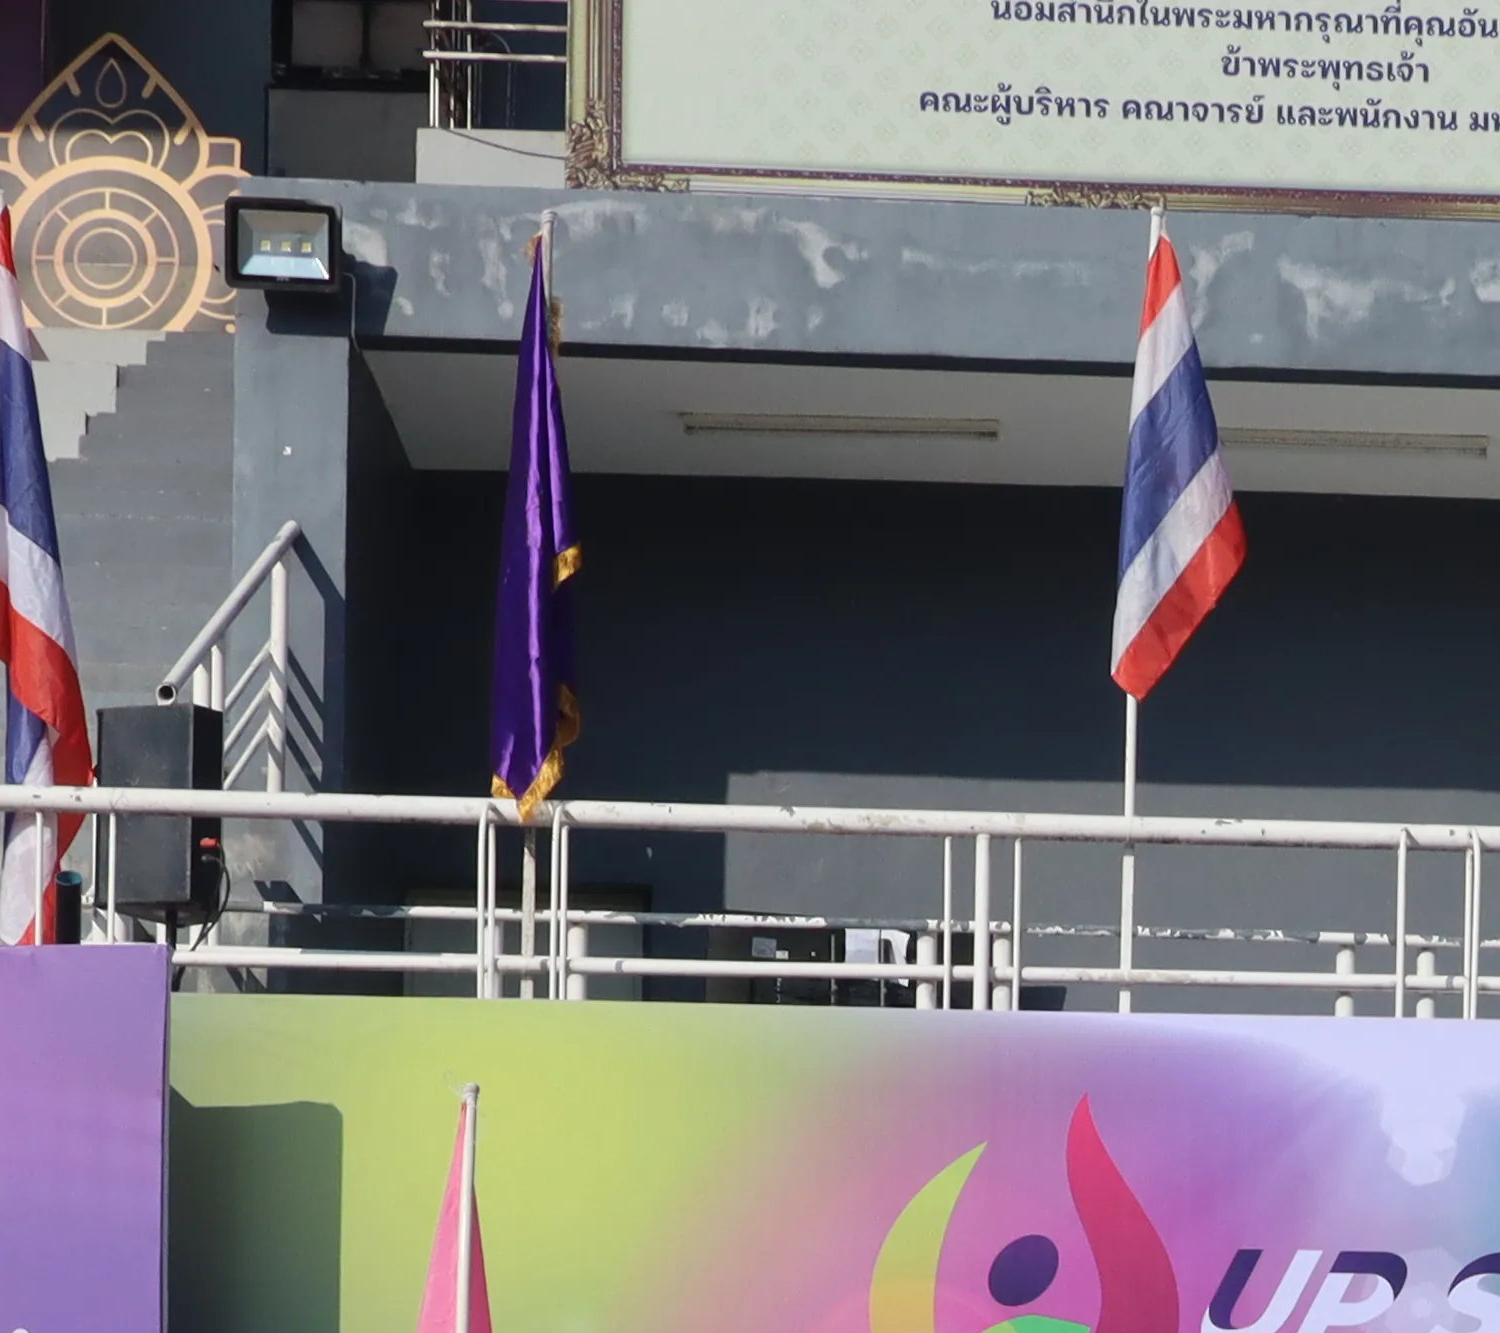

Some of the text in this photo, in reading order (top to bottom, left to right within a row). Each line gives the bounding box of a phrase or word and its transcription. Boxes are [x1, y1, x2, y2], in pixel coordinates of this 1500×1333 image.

[1221, 45, 1430, 91] ข้าพระพุทธเจ้า
[919, 82, 1110, 126] คณะผู้บริหาร
[1122, 95, 1265, 126] คณาจารย์
[1276, 98, 1459, 132] และพนักงาน
